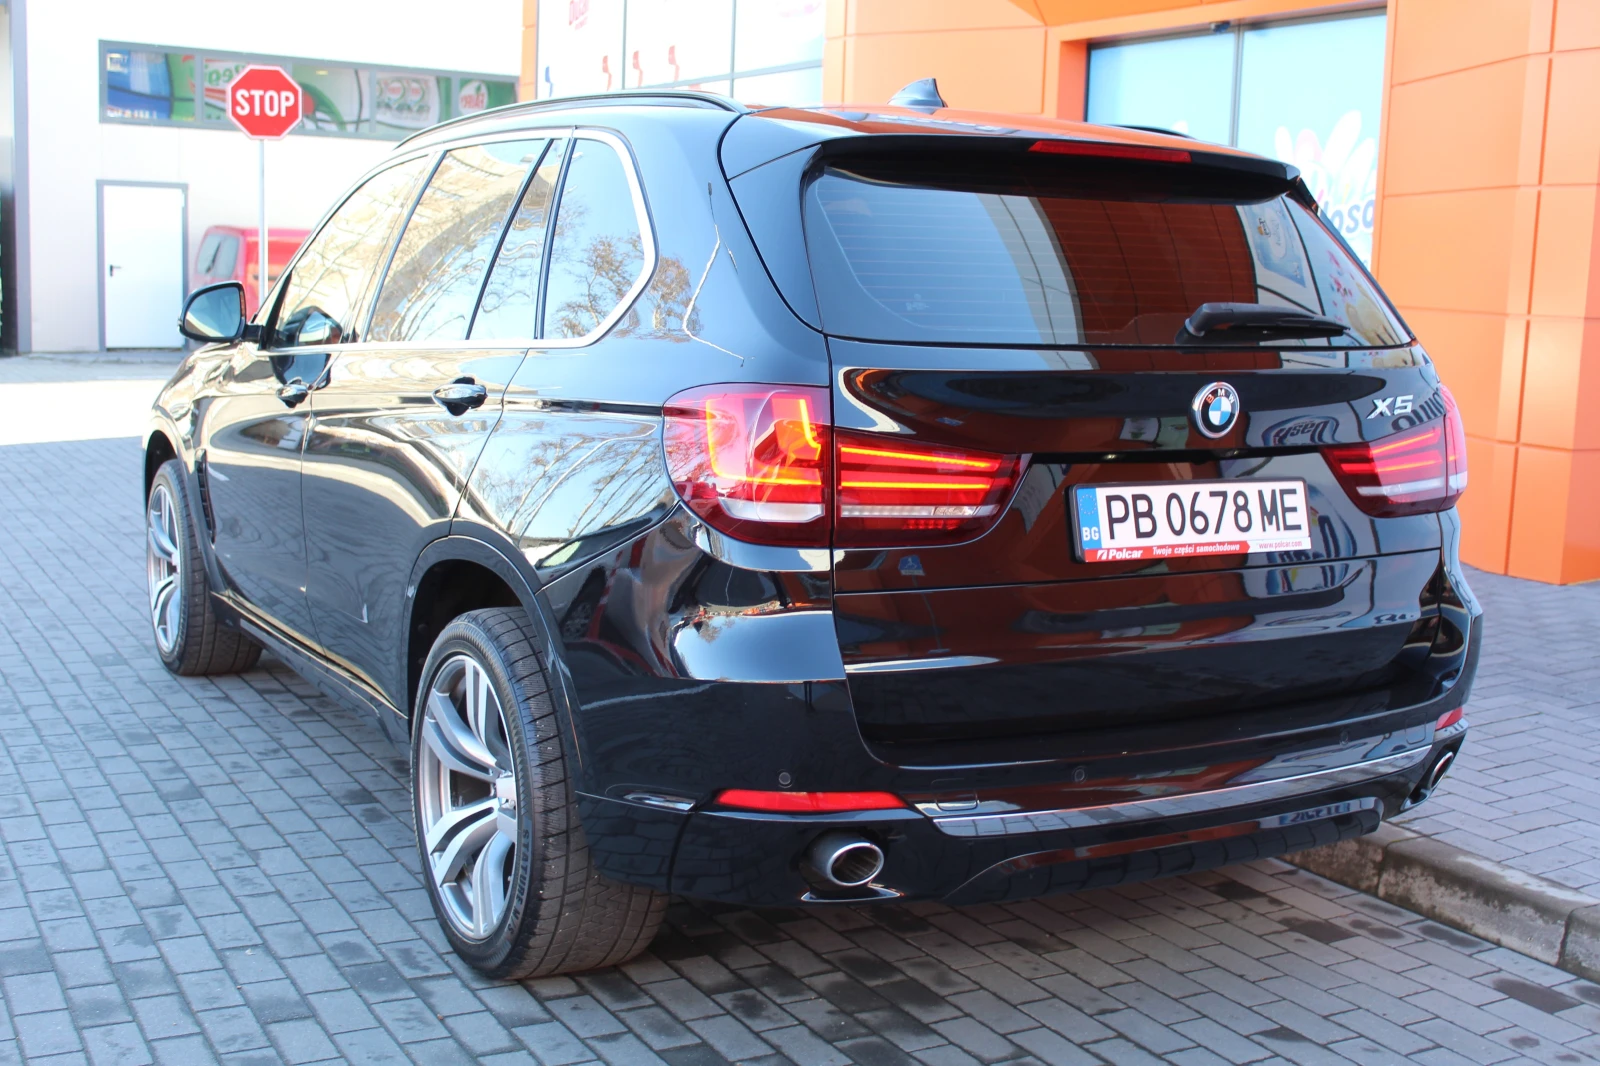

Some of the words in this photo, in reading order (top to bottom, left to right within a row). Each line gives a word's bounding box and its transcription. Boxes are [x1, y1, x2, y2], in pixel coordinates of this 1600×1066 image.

[235, 89, 296, 117] STOP
[1206, 388, 1235, 404] BMW
[1366, 394, 1414, 420] X5
[1105, 494, 1157, 540] PB
[1165, 490, 1253, 537] 0678
[1257, 488, 1302, 533] ME
[1082, 526, 1099, 541] BG
[1108, 548, 1143, 560] Polcar
[1152, 545, 1172, 556] Twoje
[1174, 544, 1194, 556] części
[1196, 542, 1240, 553] samochodowe
[1259, 540, 1303, 551] www.polcar.com
[517, 829, 530, 905] STATURE
